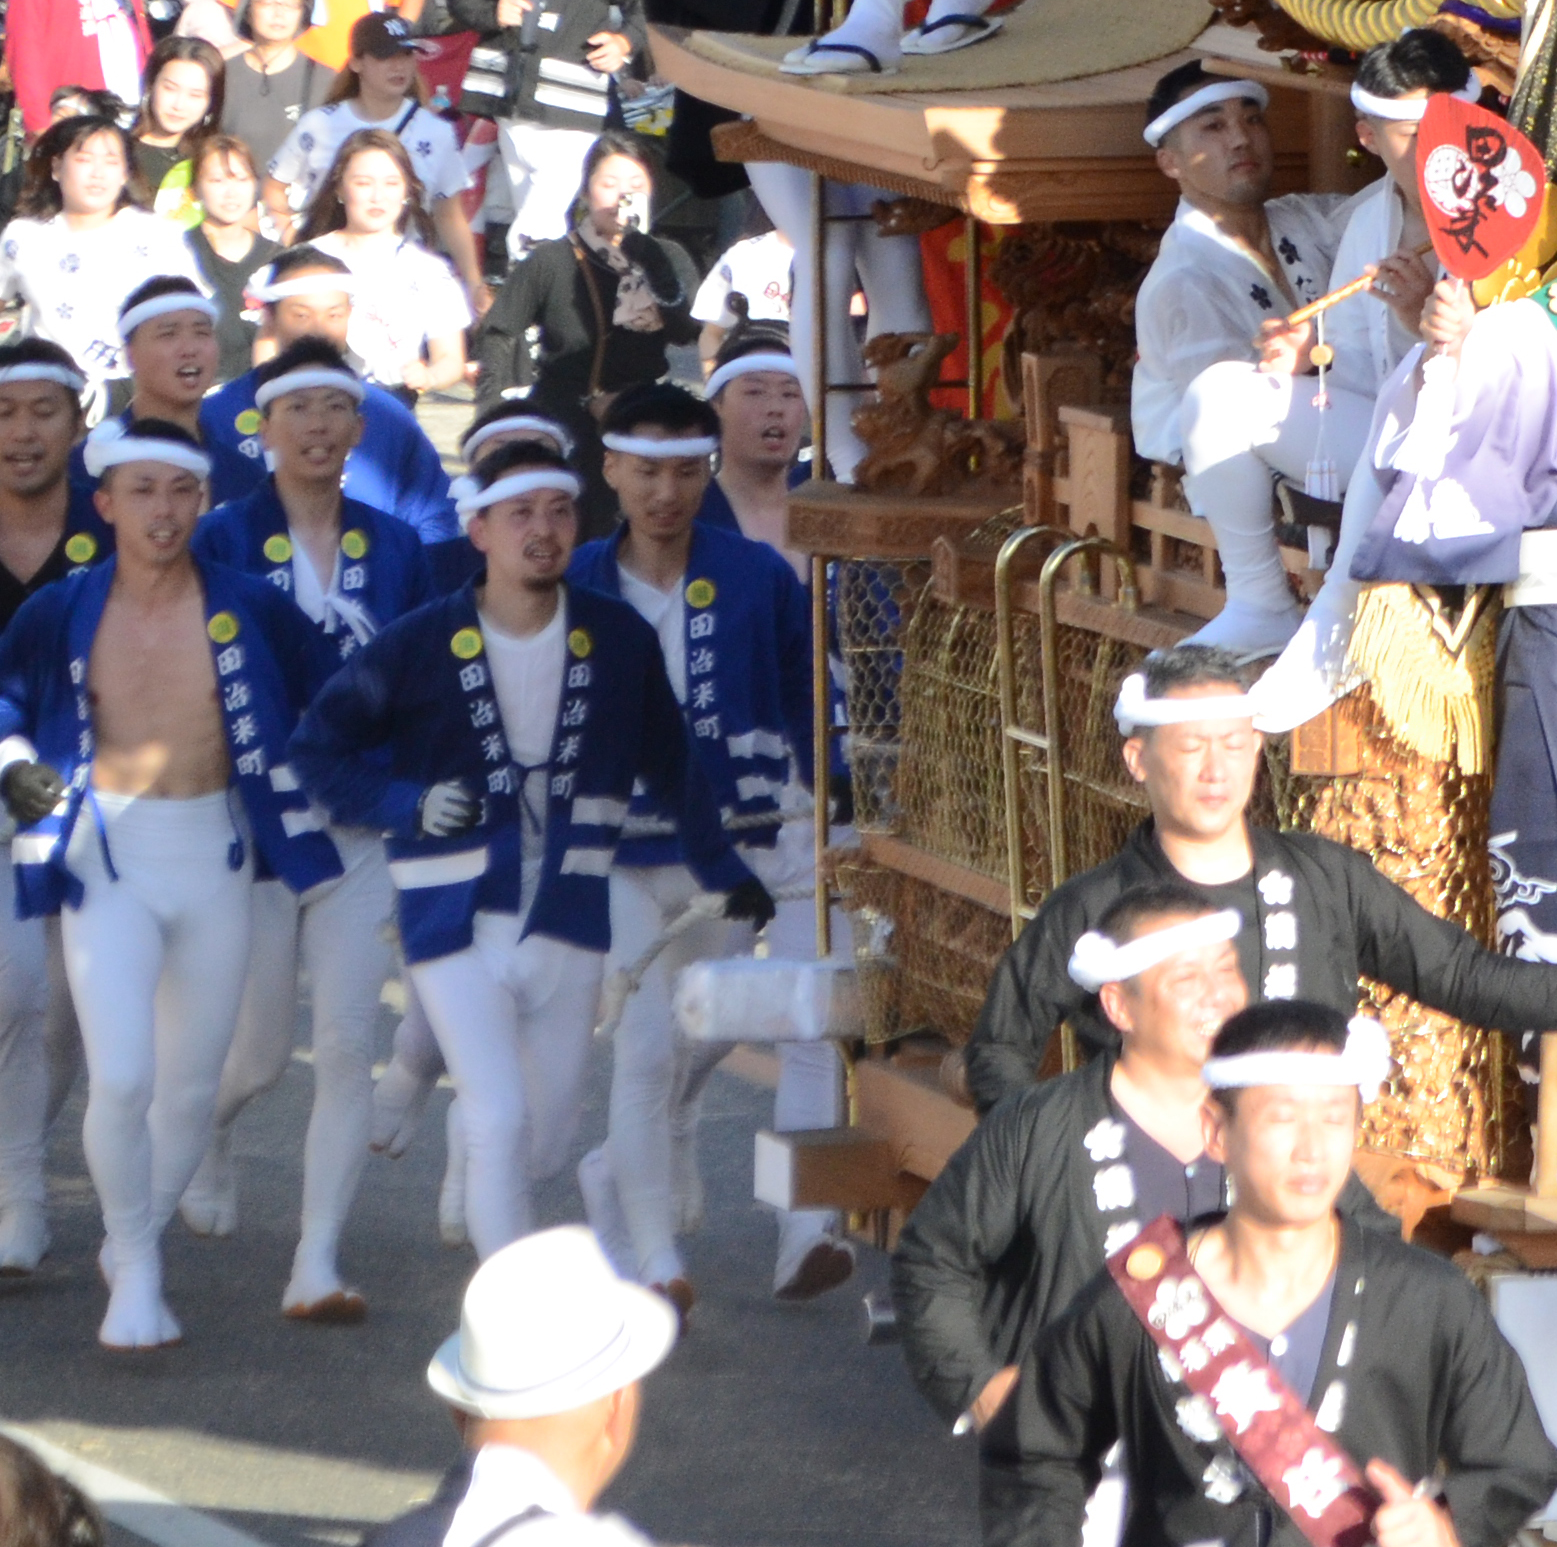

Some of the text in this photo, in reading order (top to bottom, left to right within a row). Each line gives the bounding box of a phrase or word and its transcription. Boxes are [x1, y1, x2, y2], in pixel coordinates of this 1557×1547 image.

[216, 643, 266, 777] 田治米町
[458, 662, 515, 798] 田治米町
[550, 662, 591, 800] 田治米町
[690, 612, 721, 741] 田治米町
